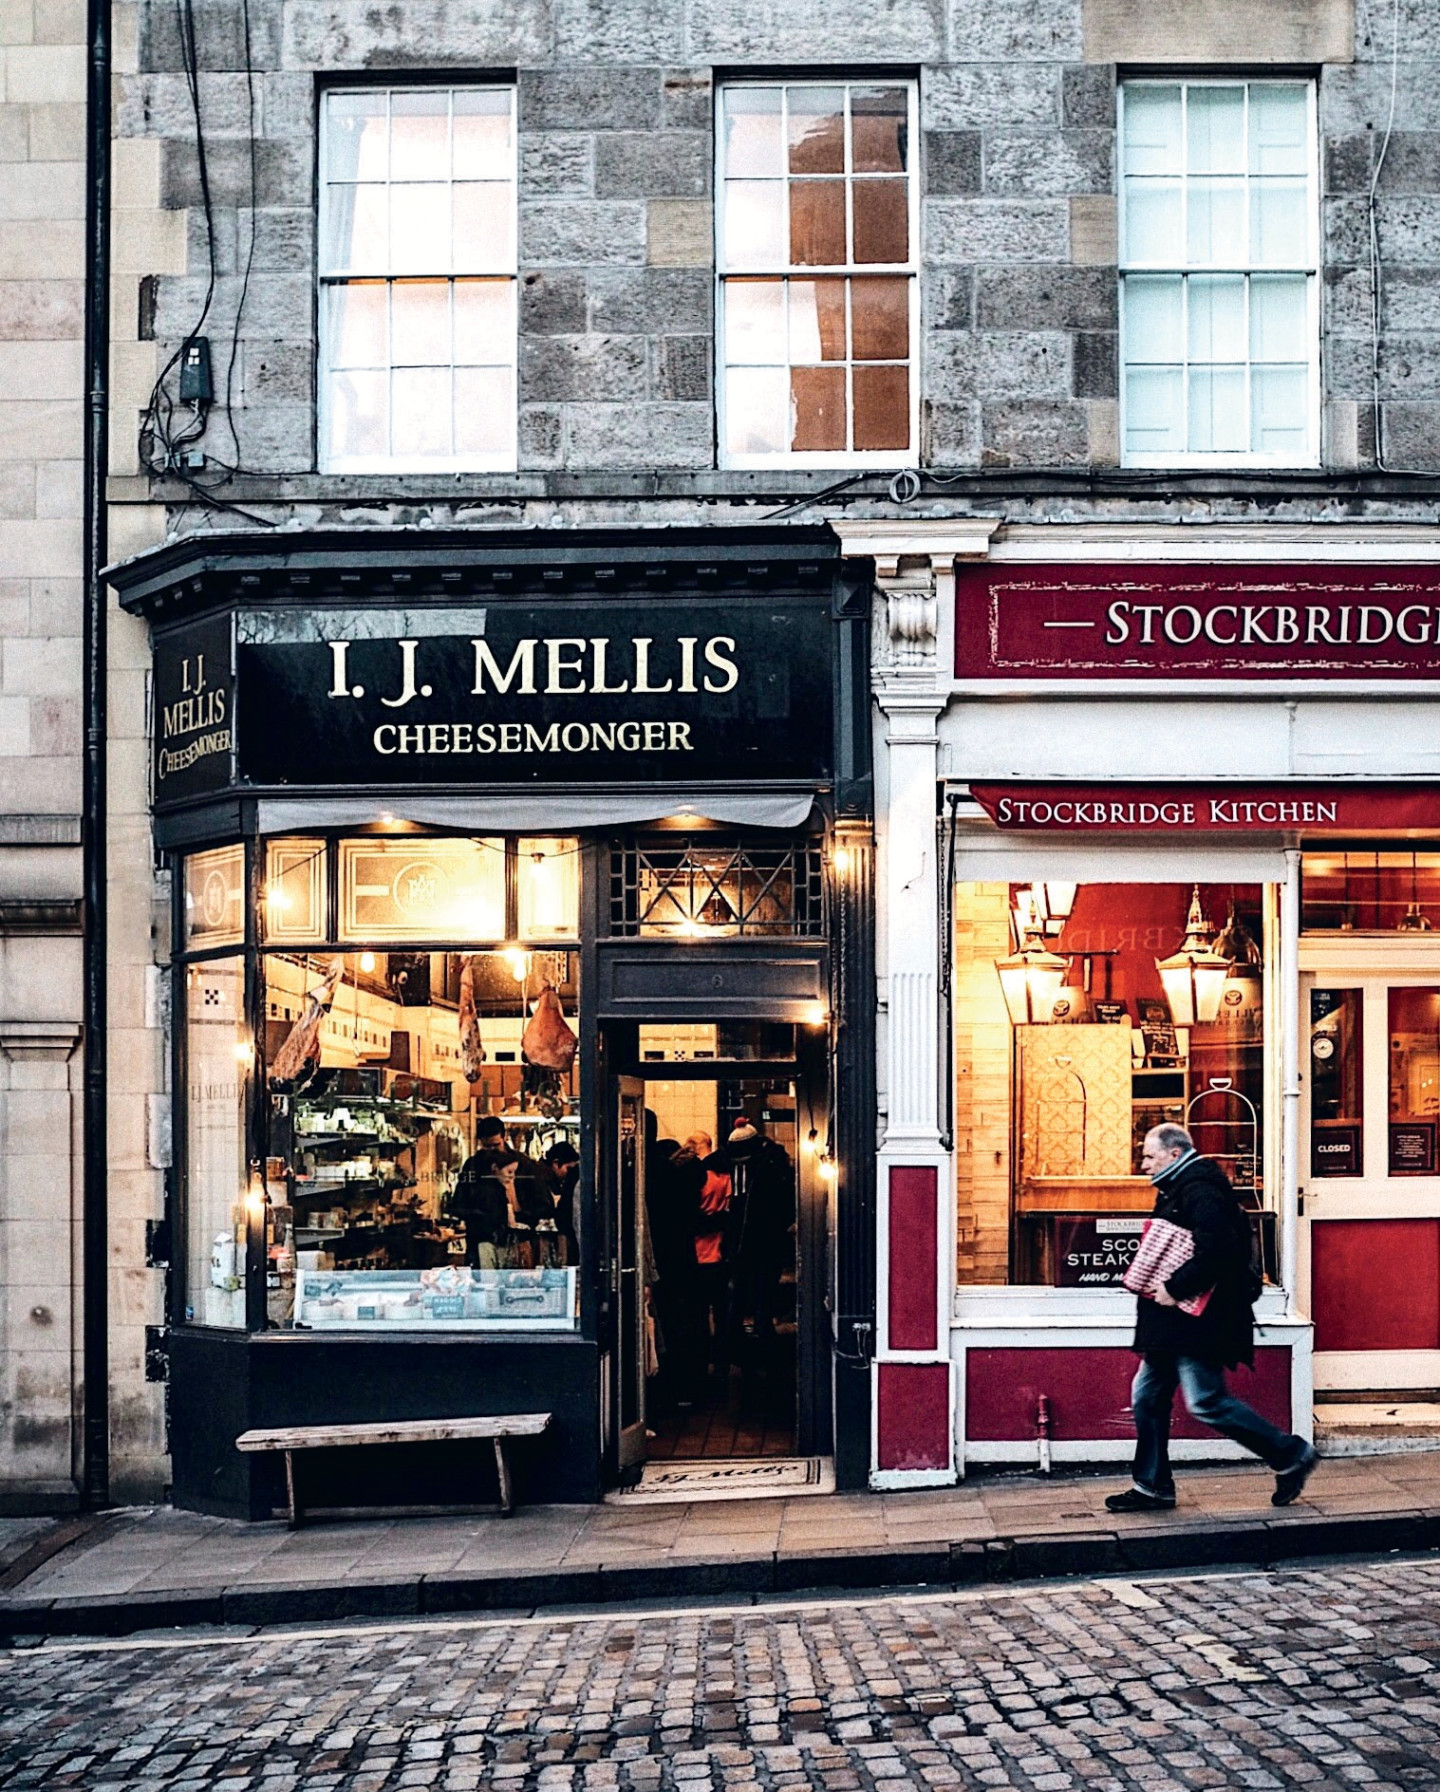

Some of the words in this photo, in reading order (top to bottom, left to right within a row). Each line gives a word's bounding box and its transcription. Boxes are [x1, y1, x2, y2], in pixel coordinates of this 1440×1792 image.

[328, 641, 364, 698] I.
[381, 641, 433, 707] J.
[470, 635, 739, 694] MELLIS
[163, 688, 225, 739] MELLIS
[373, 721, 695, 755] CHEESEMONGER
[998, 798, 1196, 824] STOCKBRIDGE
[1210, 799, 1338, 823] KITCHEN
[1317, 1144, 1351, 1153] CLOSED
[1067, 1253, 1131, 1266] STEAK
[1078, 1272, 1111, 1283] HAND
